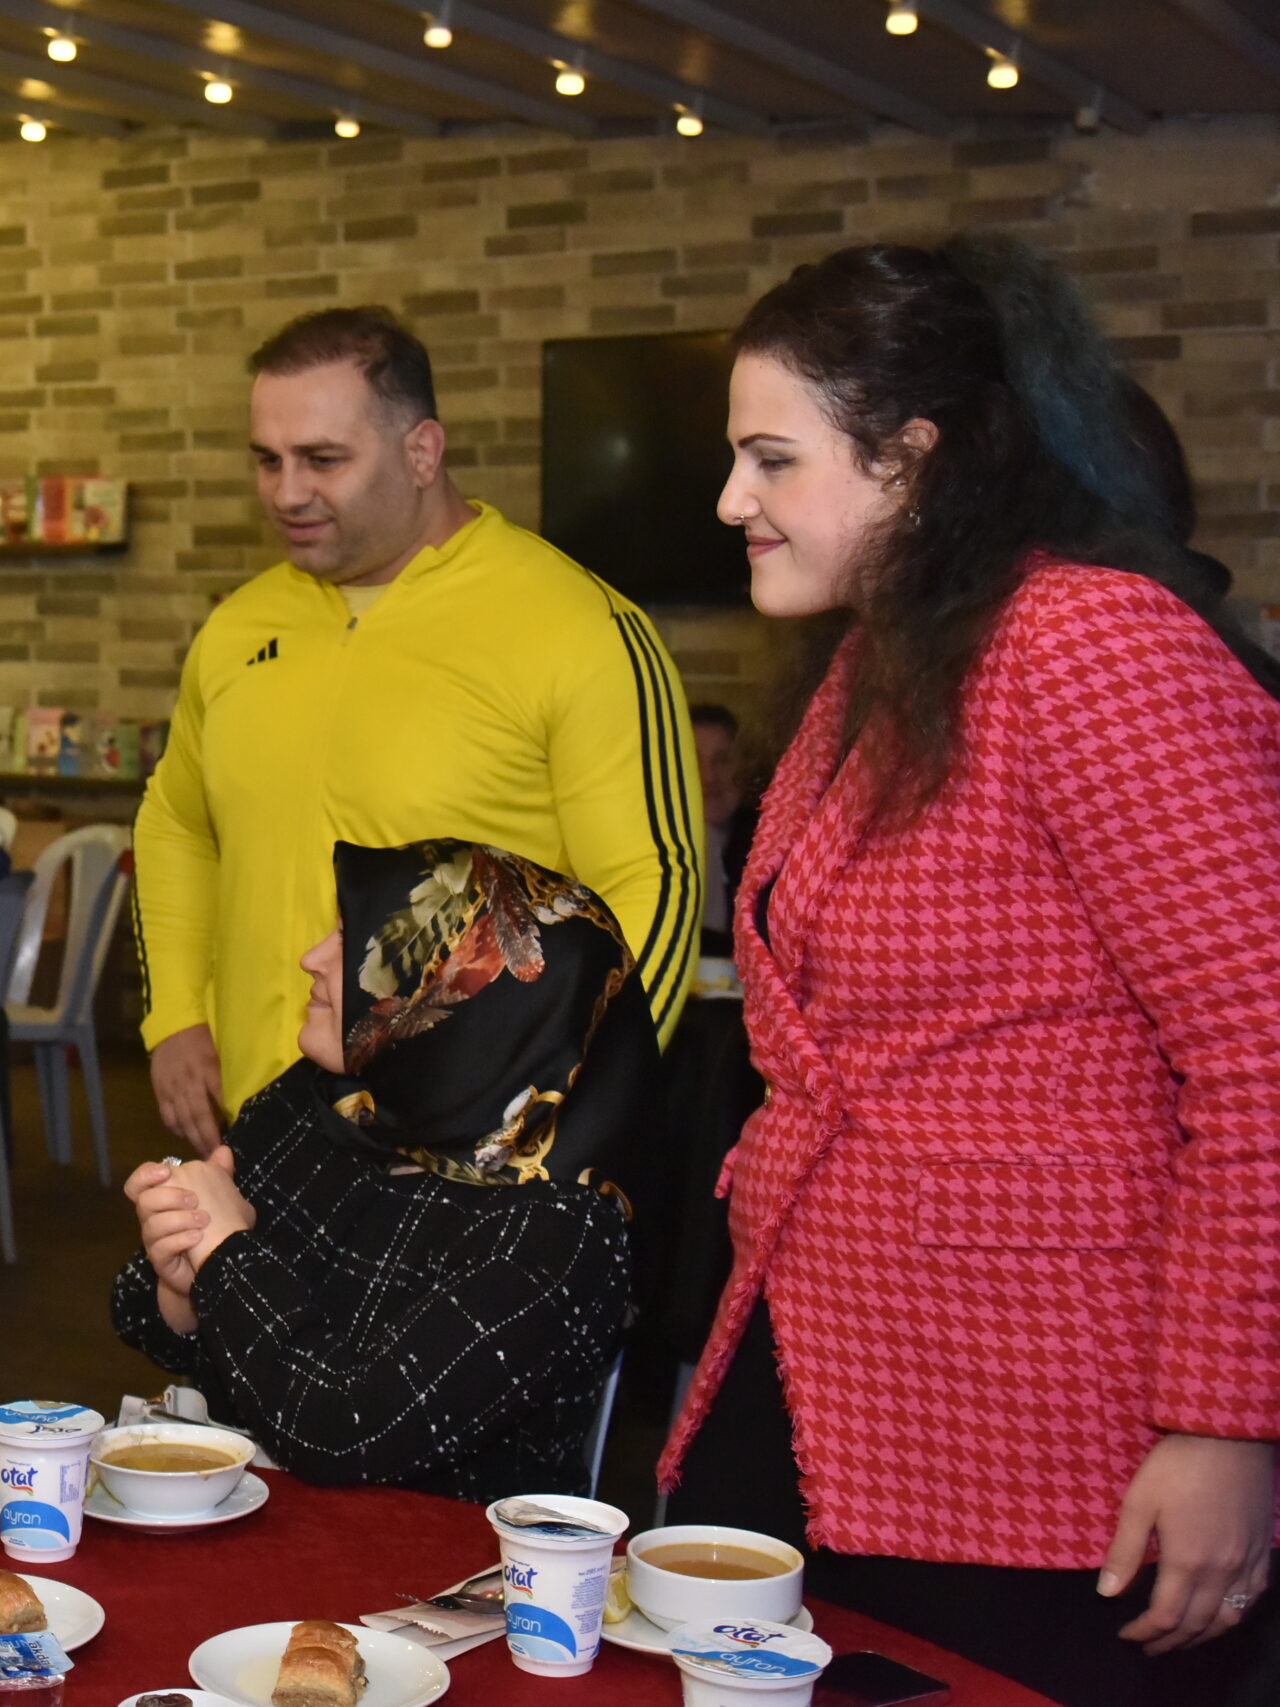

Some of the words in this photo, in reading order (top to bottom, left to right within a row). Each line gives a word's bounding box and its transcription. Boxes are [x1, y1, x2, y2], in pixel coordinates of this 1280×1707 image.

[1, 1467, 38, 1488] otat
[3, 1508, 42, 1526] ayran
[504, 1564, 538, 1589] otat
[713, 1625, 787, 1643] otat
[720, 1653, 787, 1673] ayran
